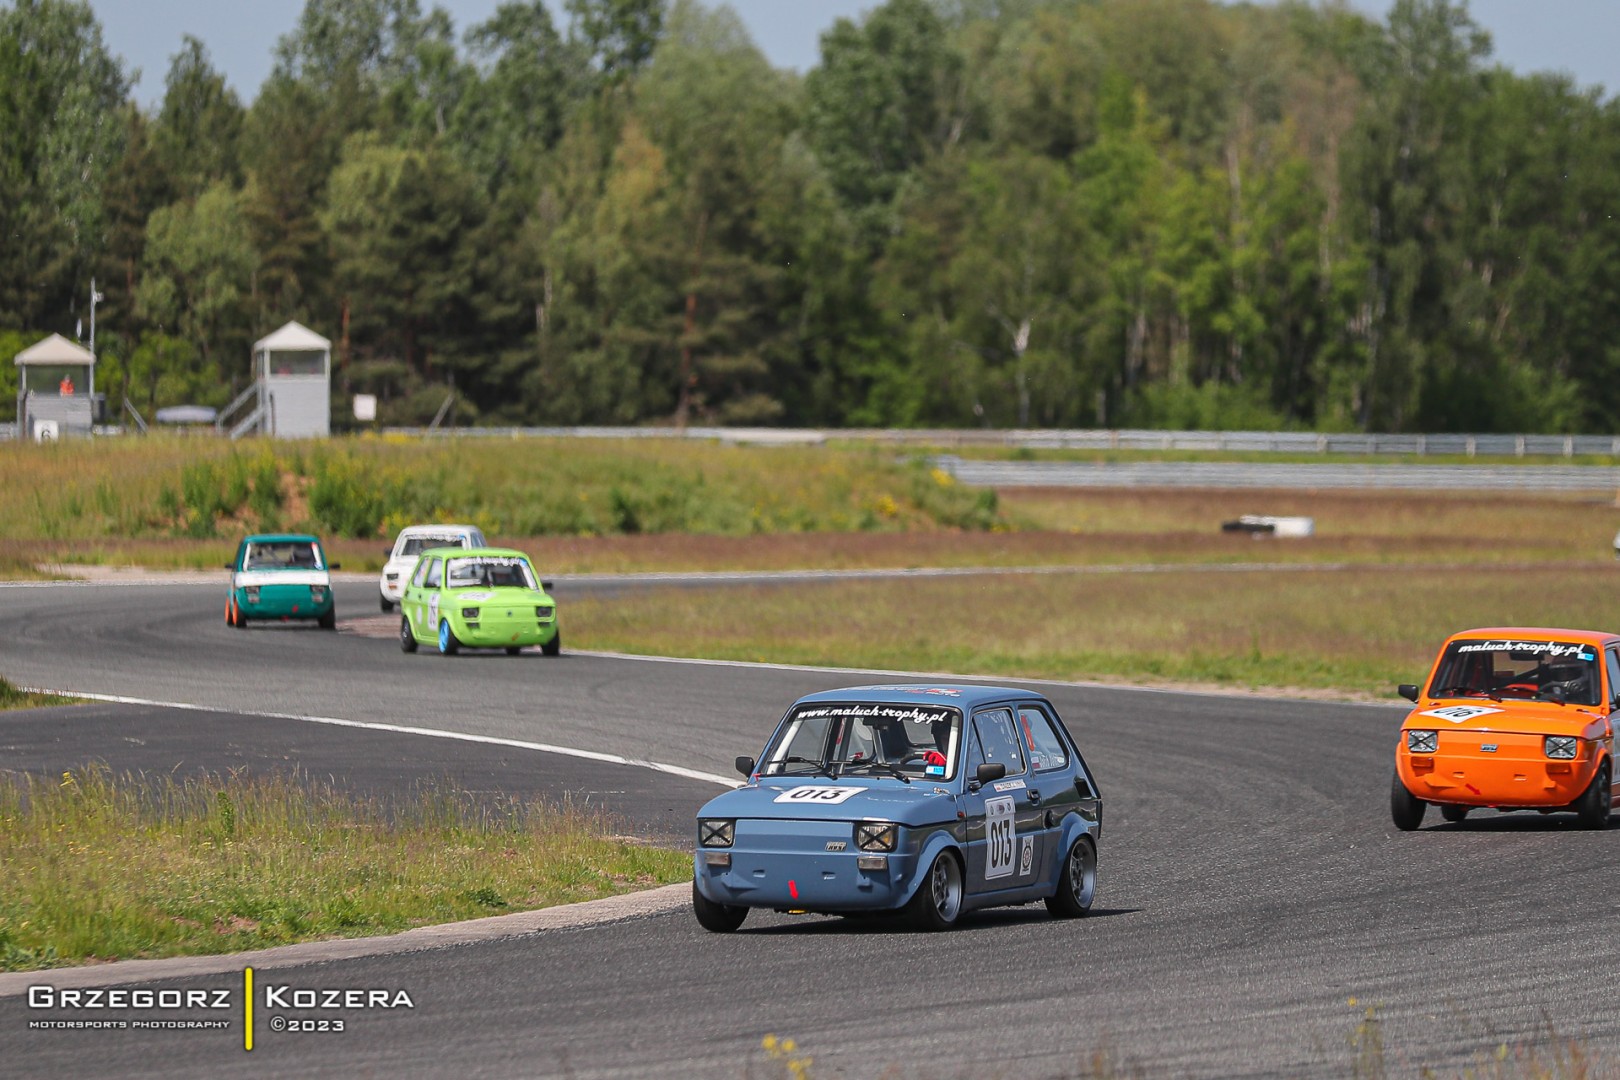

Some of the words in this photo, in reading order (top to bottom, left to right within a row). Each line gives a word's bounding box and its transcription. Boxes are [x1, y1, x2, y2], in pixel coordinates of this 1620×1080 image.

[1458, 640, 1585, 656] maluch-trophy.pl
[797, 705, 948, 724] www.maluch-trophy.pl
[790, 789, 848, 800] 013
[990, 819, 1012, 869] 013
